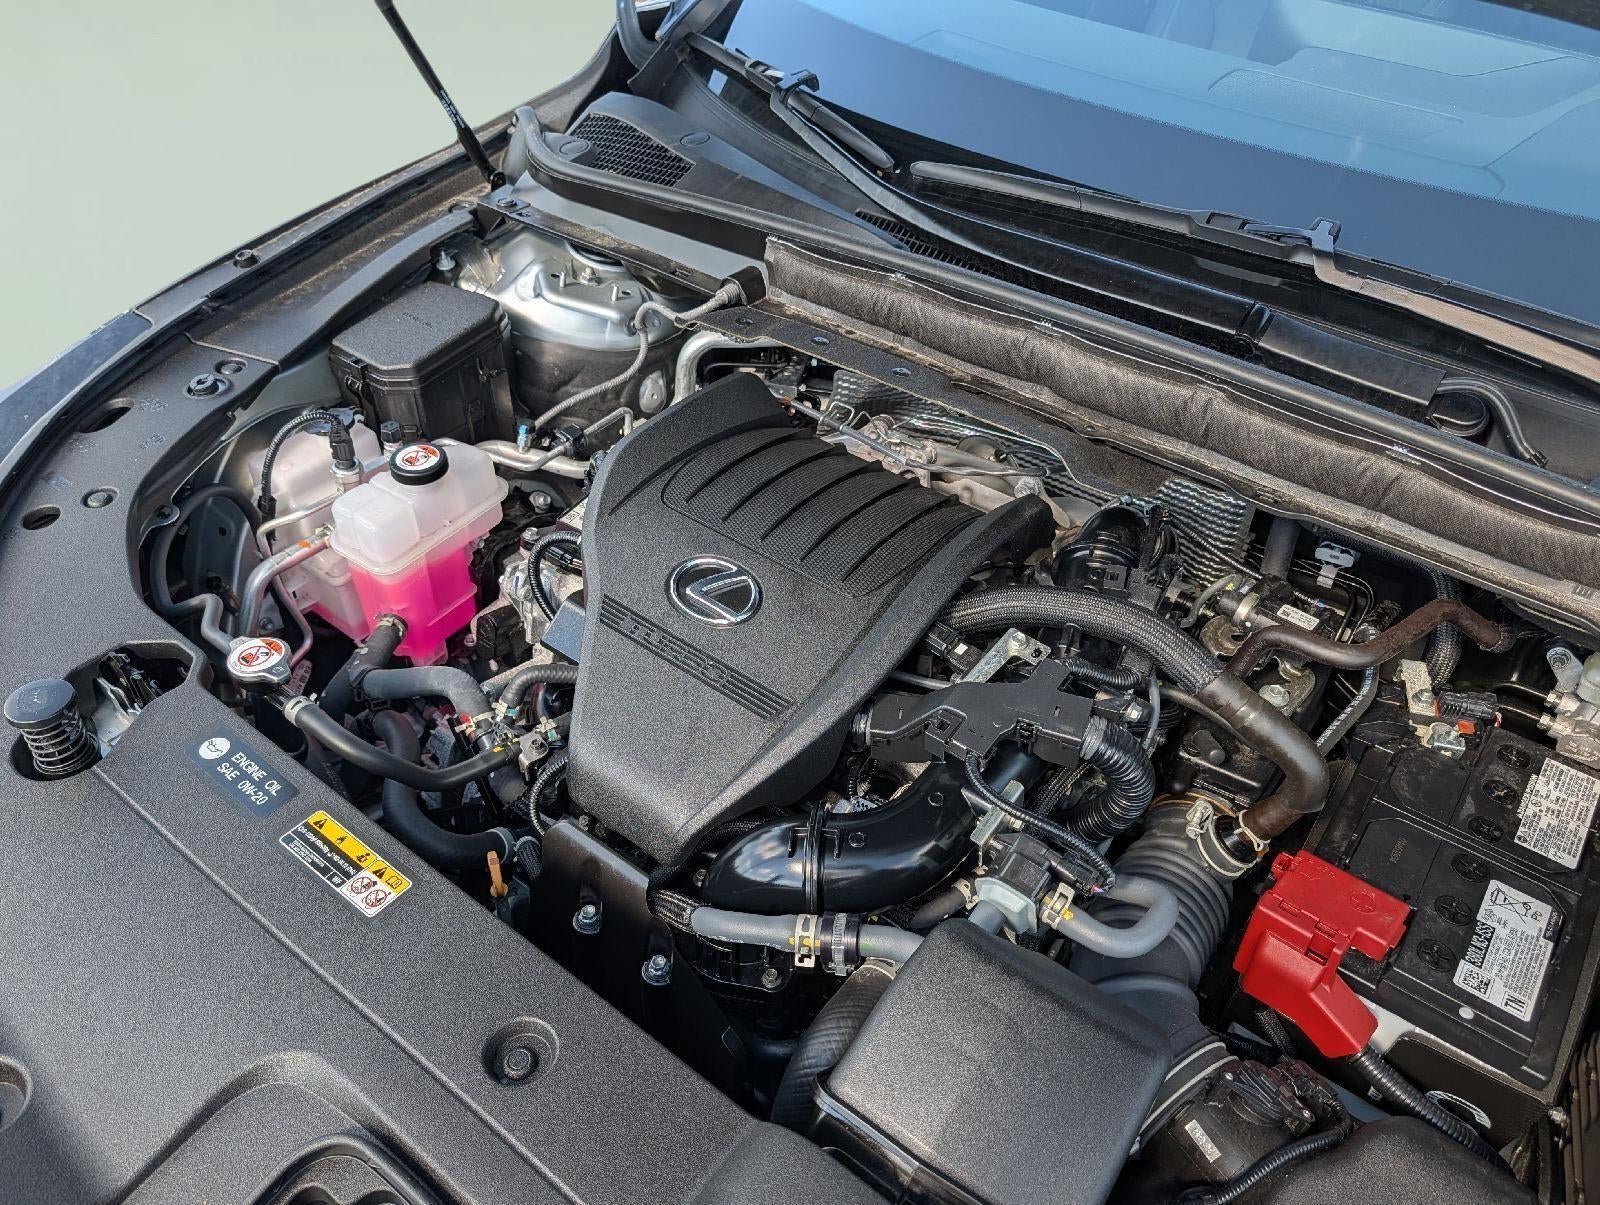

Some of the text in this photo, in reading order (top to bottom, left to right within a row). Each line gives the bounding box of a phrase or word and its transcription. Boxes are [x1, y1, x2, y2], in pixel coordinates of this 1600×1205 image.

[627, 615, 730, 686] TURBO
[217, 763, 268, 805] SAE 0W-20
[231, 752, 281, 796] ENGINE OIL
[1504, 993, 1525, 1013] TN
